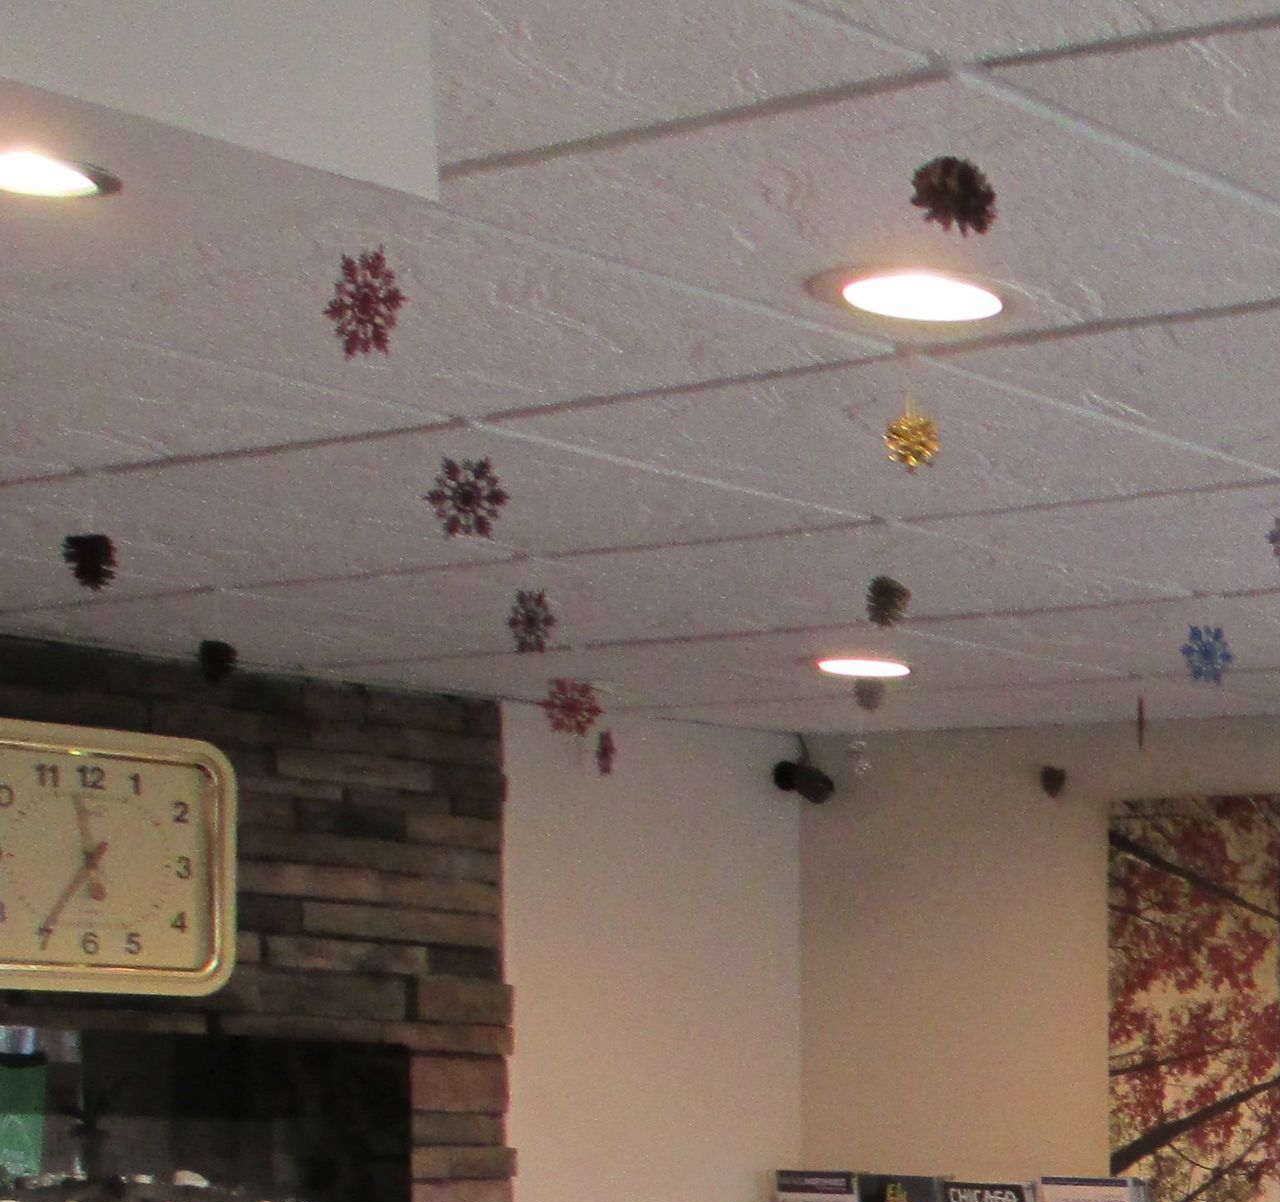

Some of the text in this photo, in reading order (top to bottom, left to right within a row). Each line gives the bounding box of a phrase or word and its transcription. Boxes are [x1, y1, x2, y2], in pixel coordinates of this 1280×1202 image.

[36, 763, 60, 788] 11
[77, 765, 105, 790] 12
[129, 772, 142, 796] 1
[173, 801, 190, 824] 2
[176, 856, 192, 880] 3
[171, 911, 189, 933] 4
[81, 932, 99, 955] 6
[126, 933, 142, 955] 5
